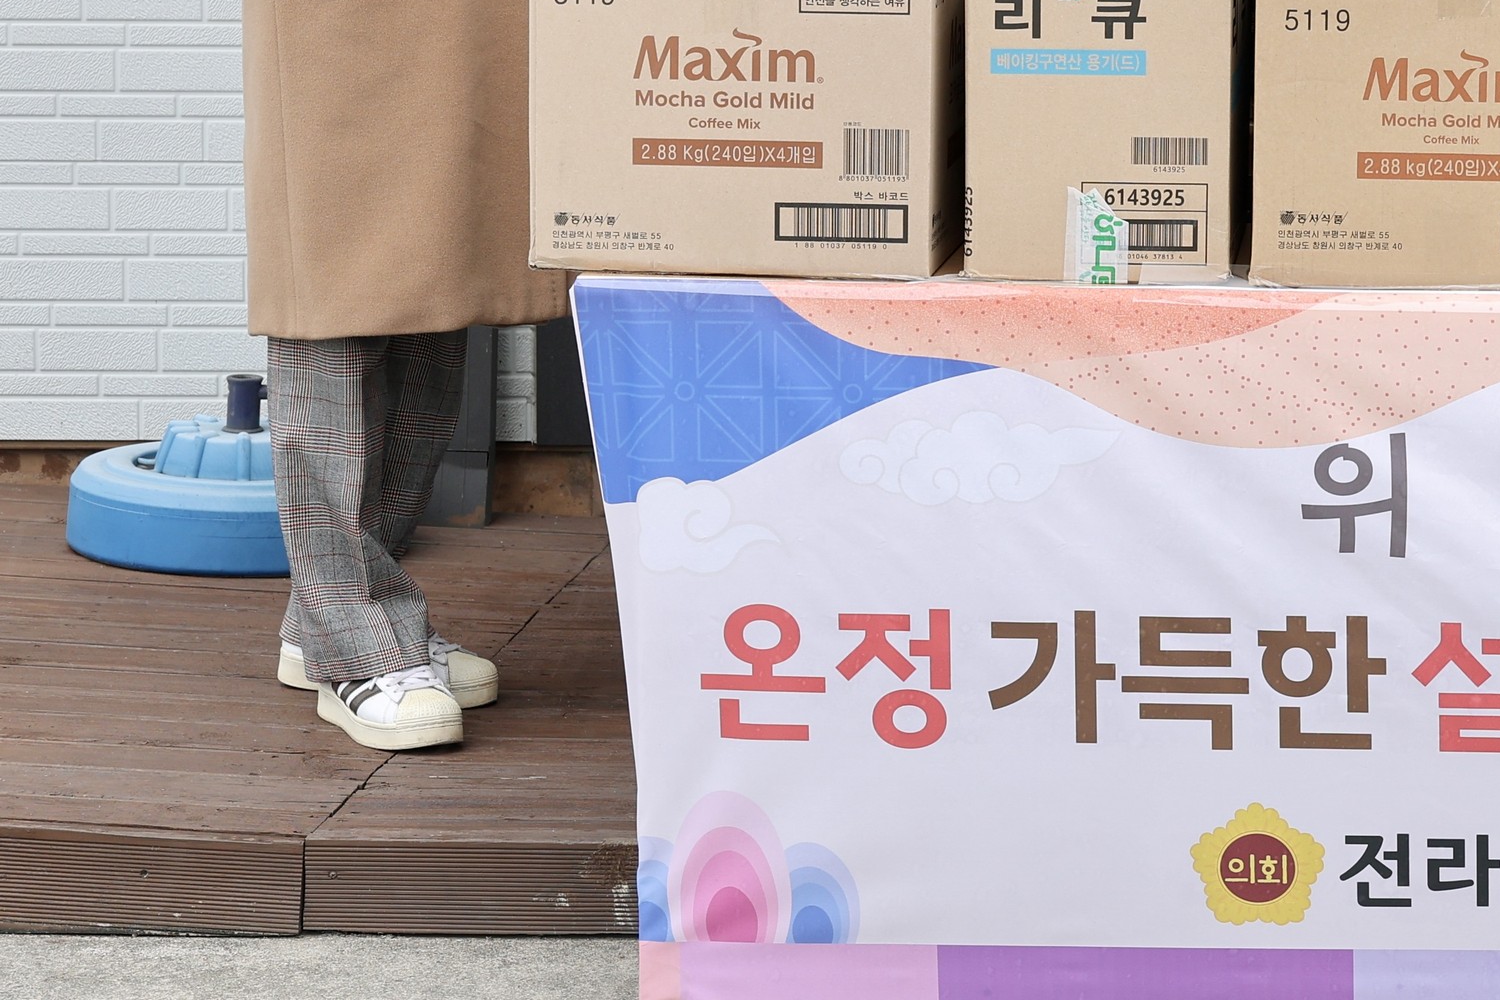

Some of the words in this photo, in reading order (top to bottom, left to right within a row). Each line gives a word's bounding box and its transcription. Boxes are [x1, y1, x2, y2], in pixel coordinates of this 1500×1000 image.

[1284, 9, 1351, 32] 5119
[632, 27, 816, 83] Maxim
[997, 53, 1082, 70] 베이킹구연산
[1086, 54, 1140, 72] 용기(드)
[634, 89, 706, 109] Mocha
[712, 90, 763, 110] Gold
[769, 90, 815, 110] Mild
[688, 118, 733, 130] Coffee
[737, 118, 761, 130] Mix
[1381, 113, 1437, 128] Mocha
[1442, 113, 1482, 129] Gold
[1423, 135, 1456, 145] Coffee
[1459, 135, 1480, 145] Mix
[641, 144, 677, 161] 2.88
[1364, 158, 1401, 175] 2.88
[853, 190, 874, 201] 박스
[878, 190, 909, 201] 바코드
[1104, 188, 1185, 206] 6143925
[571, 213, 619, 226] 동서식품
[1297, 212, 1347, 225] 동서식품
[552, 230, 594, 239] 인천광역시
[595, 230, 621, 240] 부평구
[650, 231, 662, 240] 55
[1278, 230, 1320, 239] 인천광역시
[1322, 230, 1347, 239] 부평구
[1378, 231, 1389, 239] 55
[552, 241, 583, 251] 경상남도
[585, 241, 609, 251] 창원시
[611, 241, 636, 251] 의창구
[663, 242, 674, 251] 40
[1277, 241, 1309, 250] 경상남도
[1311, 241, 1336, 250] 창원시
[1338, 241, 1362, 251] 의창구
[1391, 242, 1403, 250] 40
[700, 603, 952, 750] 온정
[988, 609, 1388, 750] 가득한
[1224, 854, 1290, 886] 의회
